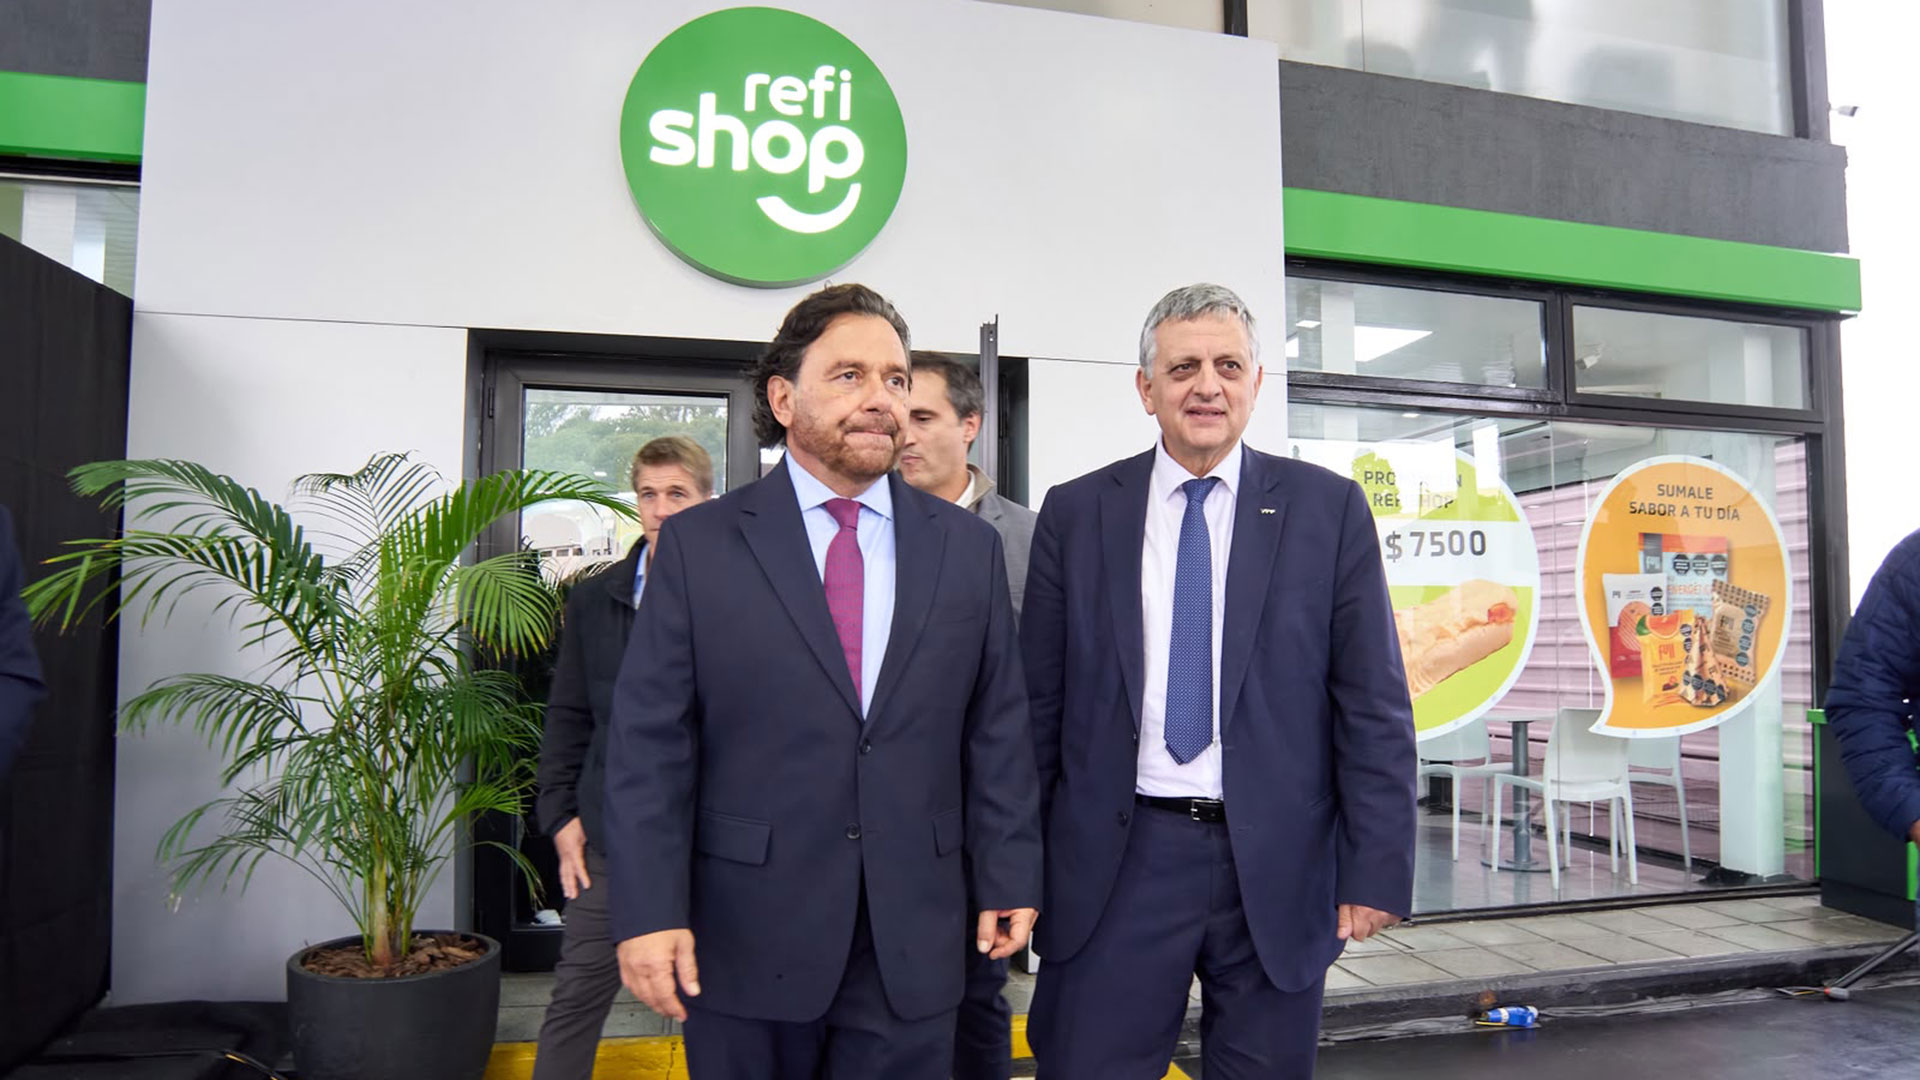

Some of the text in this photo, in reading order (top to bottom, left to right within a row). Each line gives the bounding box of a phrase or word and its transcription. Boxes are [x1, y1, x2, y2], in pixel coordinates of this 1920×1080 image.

[744, 64, 852, 121] refi
[649, 92, 865, 194] shop
[1657, 484, 1713, 500] SUMALE
[1629, 502, 1740, 521] SABOR A TU DÍA
